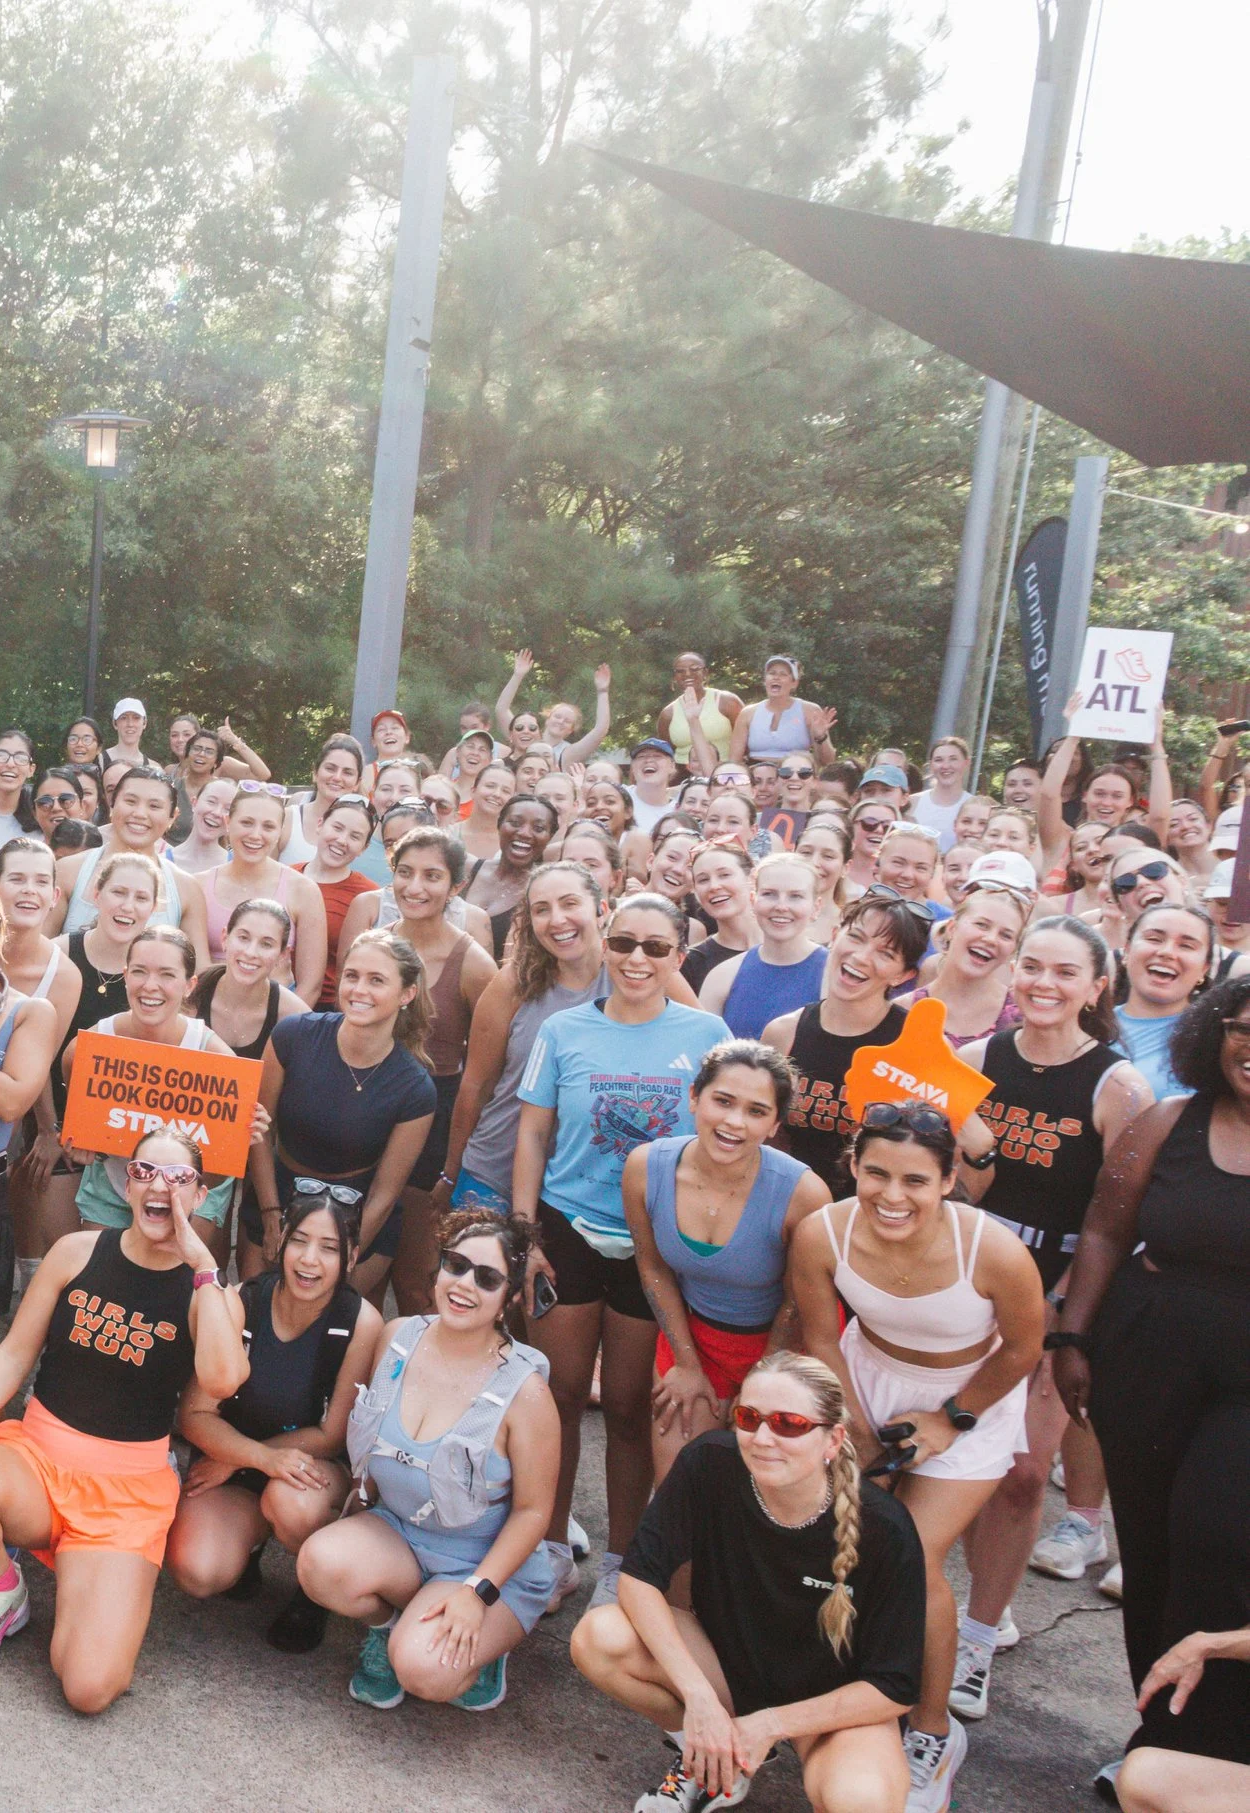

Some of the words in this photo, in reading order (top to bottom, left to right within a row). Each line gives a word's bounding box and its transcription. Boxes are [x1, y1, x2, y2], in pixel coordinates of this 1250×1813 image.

[1023, 561, 1048, 671] running
[1094, 649, 1107, 679] I
[1085, 683, 1147, 714] ATL
[92, 1055, 139, 1081] THIS
[141, 1064, 162, 1085] IS
[164, 1068, 239, 1099] GONNA
[589, 1082, 634, 1093] PEACHTREE
[640, 1084, 662, 1093] ROAD
[663, 1085, 682, 1097] RACE
[871, 1060, 949, 1109] STRAVA
[86, 1078, 143, 1106] LOOK
[145, 1089, 204, 1116] GOOD
[206, 1101, 238, 1122] ON
[975, 1098, 1083, 1136] GIRLS
[981, 1117, 1061, 1150] WHO
[993, 1138, 1053, 1168] UN
[68, 1289, 177, 1341] GIRLS
[74, 1308, 154, 1349] WHO
[68, 1325, 146, 1366] RUN
